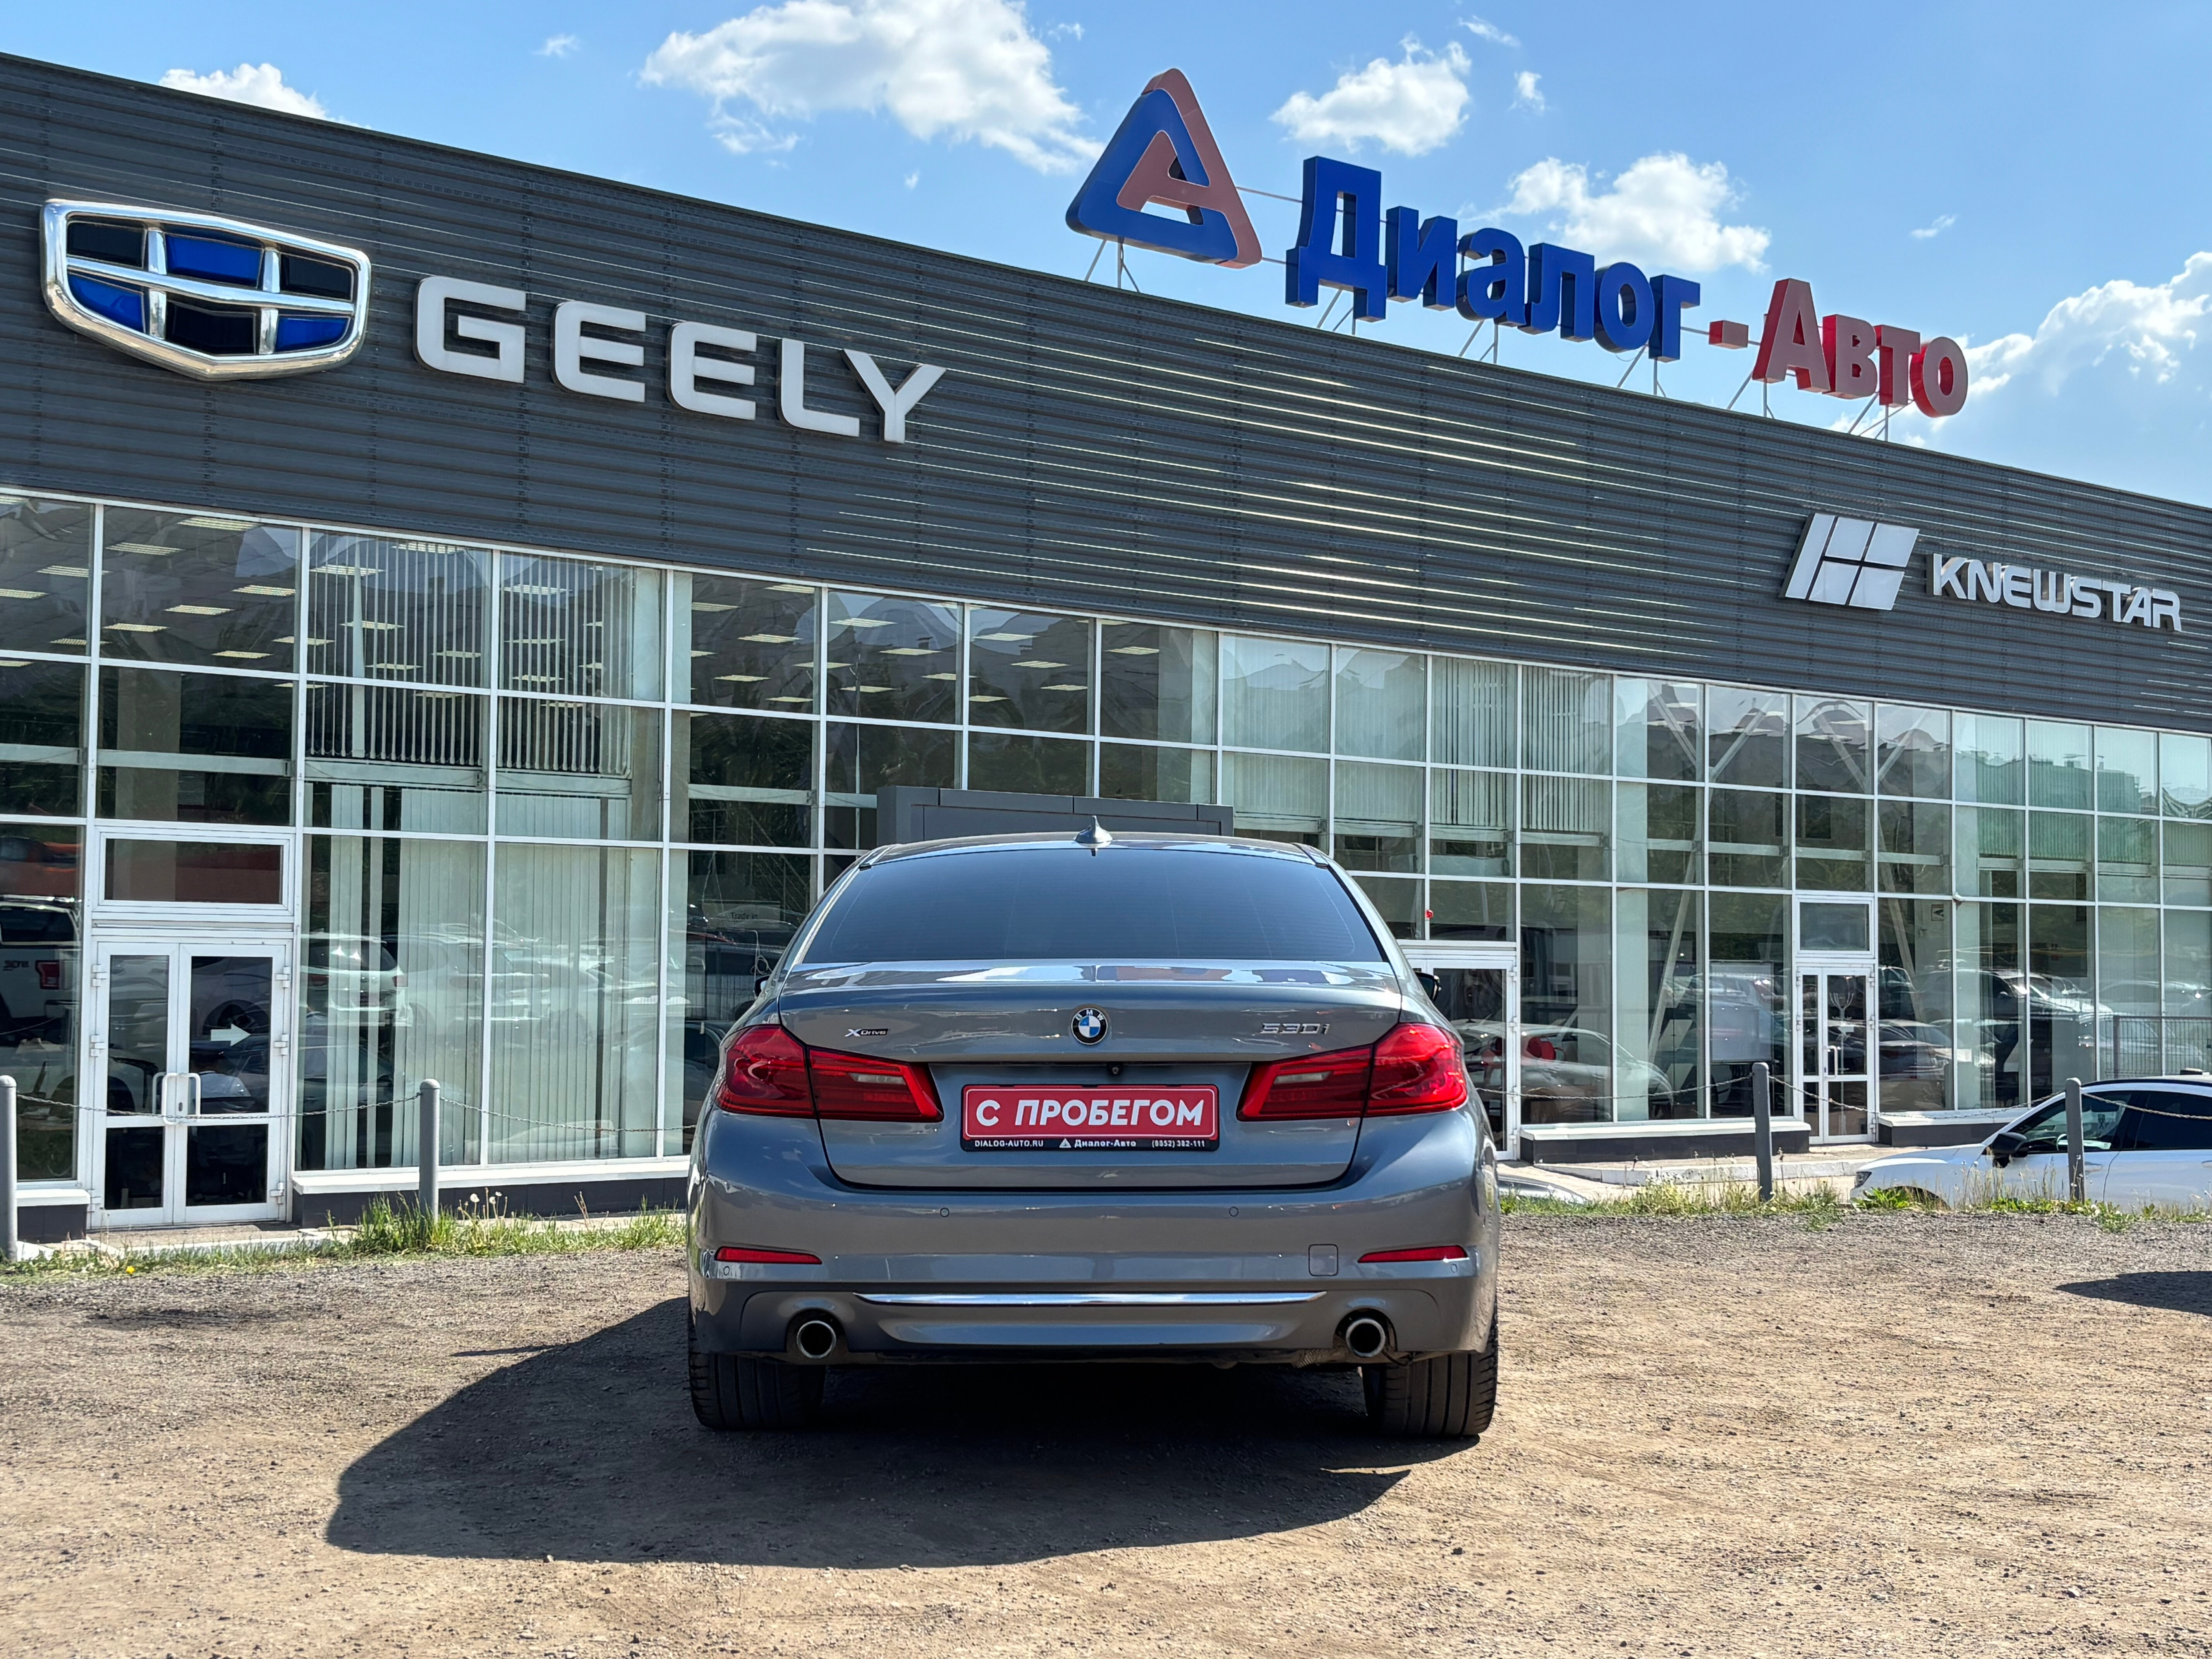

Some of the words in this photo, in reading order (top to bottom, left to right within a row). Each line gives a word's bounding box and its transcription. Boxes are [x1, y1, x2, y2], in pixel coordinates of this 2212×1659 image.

[1286, 156, 1968, 417] Диалог-Авто
[413, 275, 946, 444] GEELY
[1928, 553, 2181, 631] KNEWSTAR
[1260, 1023, 1330, 1034] 530i
[976, 1099, 1001, 1126] С
[1015, 1099, 1204, 1126] ПРОБЕГОМ
[1074, 1139, 1137, 1147] Диалог-Авто
